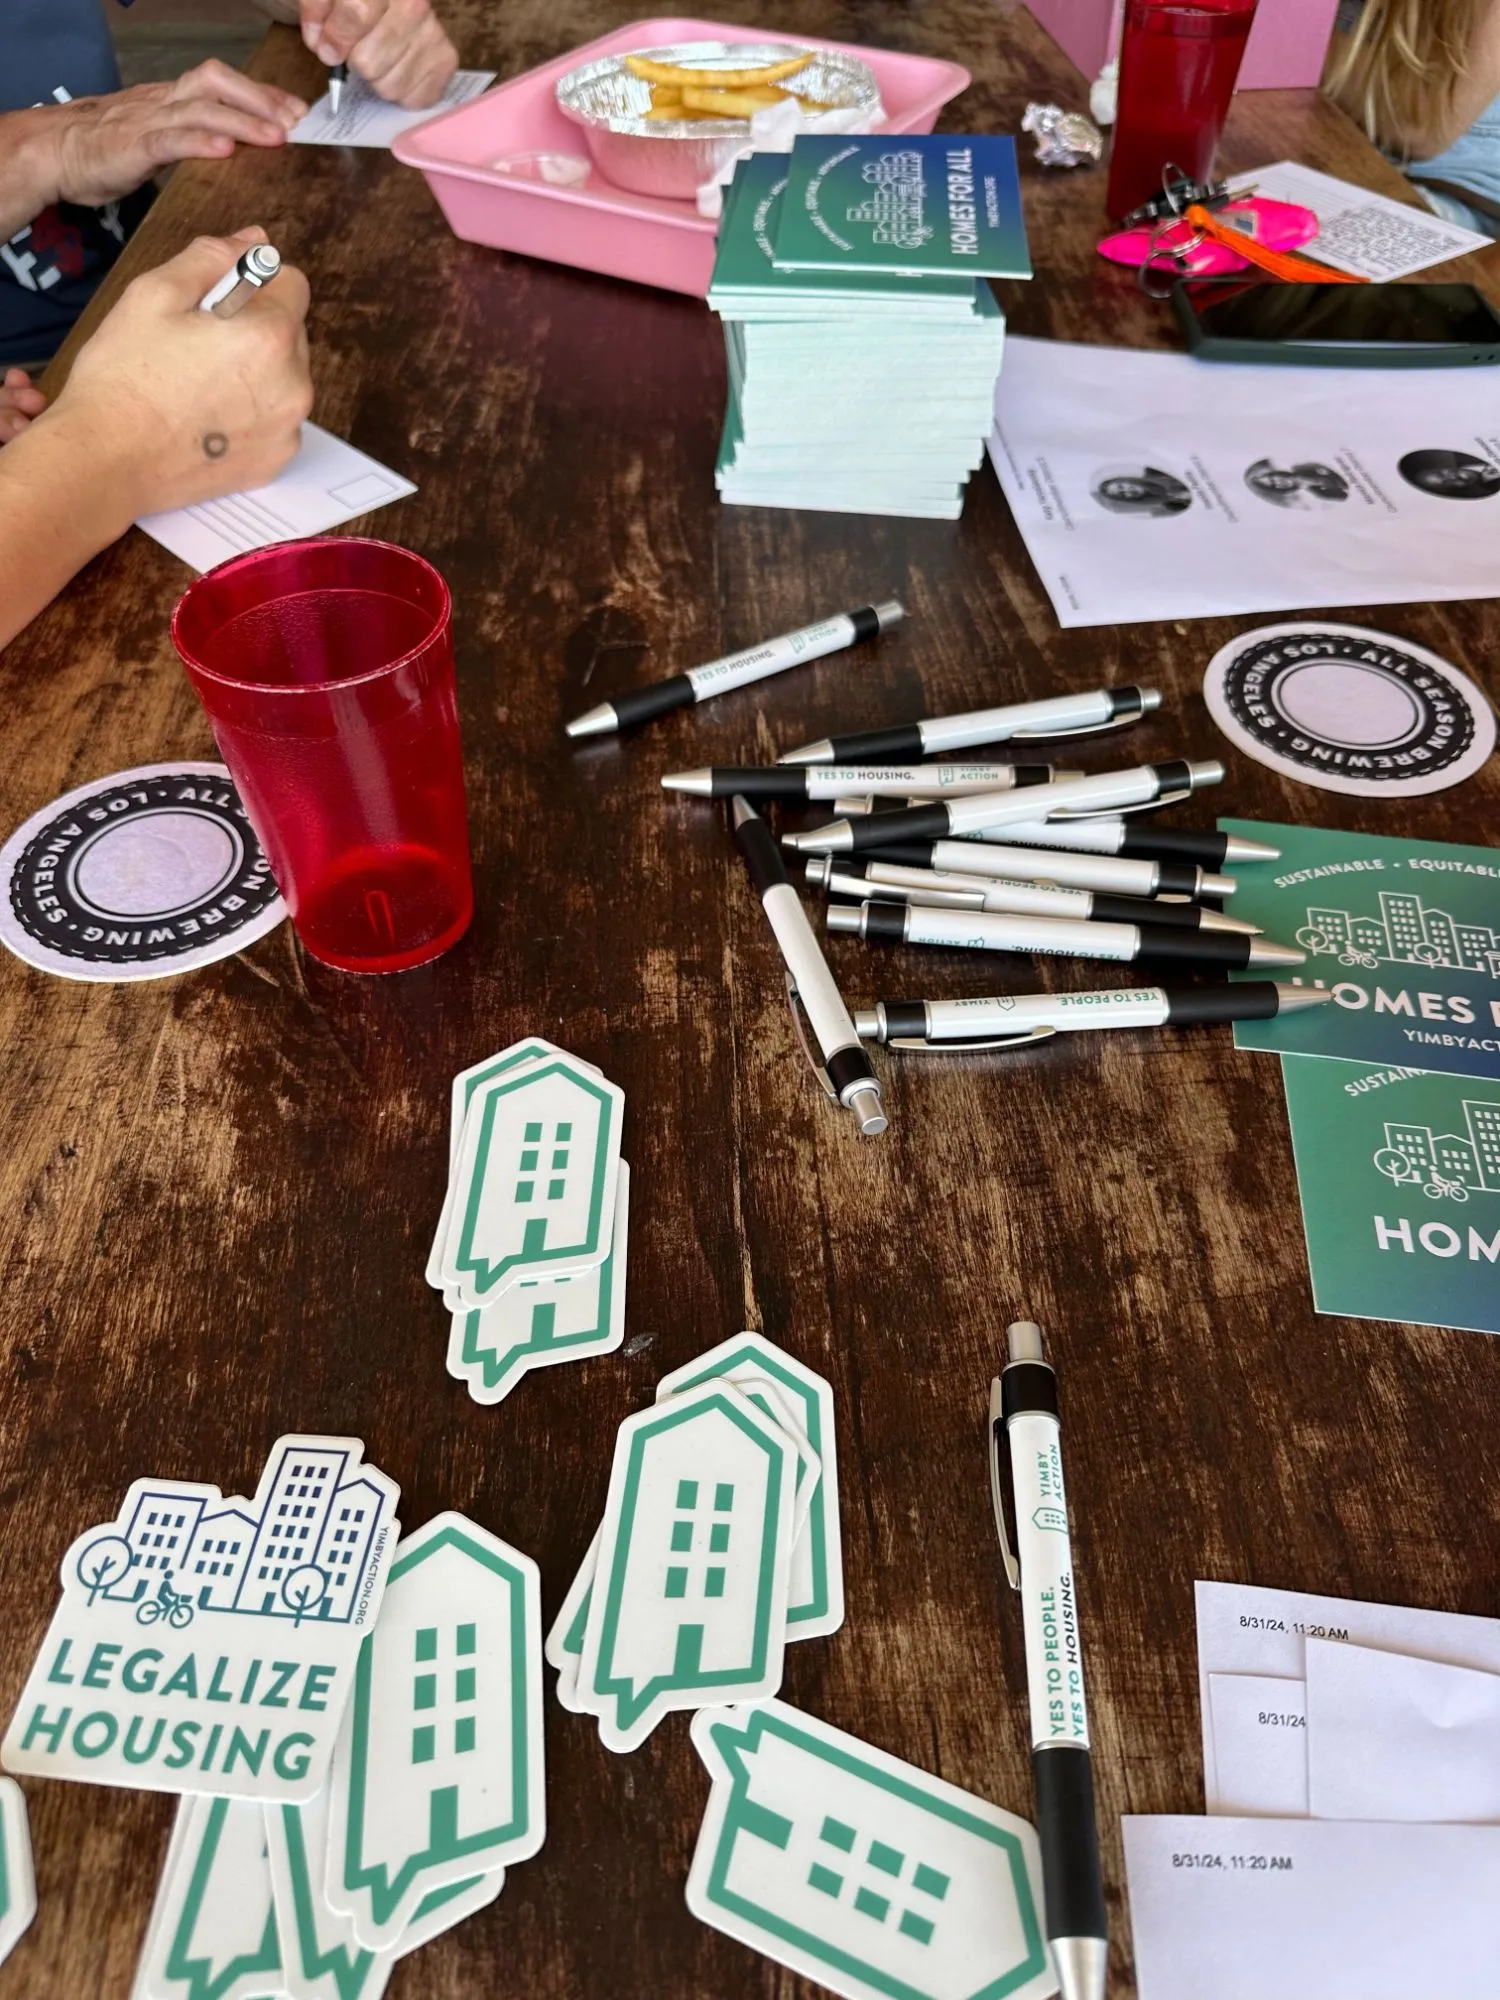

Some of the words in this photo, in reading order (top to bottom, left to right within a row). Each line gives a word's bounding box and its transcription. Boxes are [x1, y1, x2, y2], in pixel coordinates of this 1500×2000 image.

[945, 147, 973, 173] ALL
[946, 175, 976, 202] FOR
[948, 203, 980, 255] HOMES
[1282, 643, 1335, 658] LOS
[1360, 649, 1410, 676] ALL
[1242, 653, 1281, 729] ANGELES
[1413, 676, 1455, 749] SEASON
[1290, 737, 1432, 769] BREWING
[817, 771, 837, 780] YES
[839, 771, 855, 780] TO
[858, 771, 916, 781] HOUSING.
[960, 772, 999, 781] ACTION
[87, 791, 149, 822] LOS
[179, 786, 230, 808] ALL
[33, 822, 84, 924] ANGELES
[1273, 858, 1385, 889] SUSTAINABLE
[82, 894, 248, 946] BREWING
[1056, 994, 1112, 1006] PEOPLE.
[1114, 994, 1135, 1003] TO
[1137, 992, 1159, 1002] YES
[1292, 976, 1476, 1025] OMES
[1040, 1451, 1050, 1497] YIMBY
[1050, 1443, 1063, 1500] ACTION
[354, 1525, 390, 1626] YIMBYACTION.ORG
[1040, 1586, 1059, 1663] PEOPLE.
[1060, 1571, 1078, 1664] HOUSING.
[1239, 1615, 1290, 1634] 8/31/24,
[1292, 1622, 1326, 1638] 11:20
[1328, 1626, 1349, 1641] AM
[47, 1637, 338, 1713] LEGALIZE
[1048, 1667, 1062, 1696] TO
[1068, 1669, 1081, 1698] TO
[1051, 1698, 1066, 1737] YES
[1071, 1700, 1086, 1738] YES
[1258, 1711, 1307, 1728] 8/31/24
[20, 1703, 317, 1781] HOUSING
[1171, 1853, 1227, 1871] 8/31/24,
[1229, 1855, 1267, 1870] 11:20
[1268, 1856, 1293, 1871] AM
